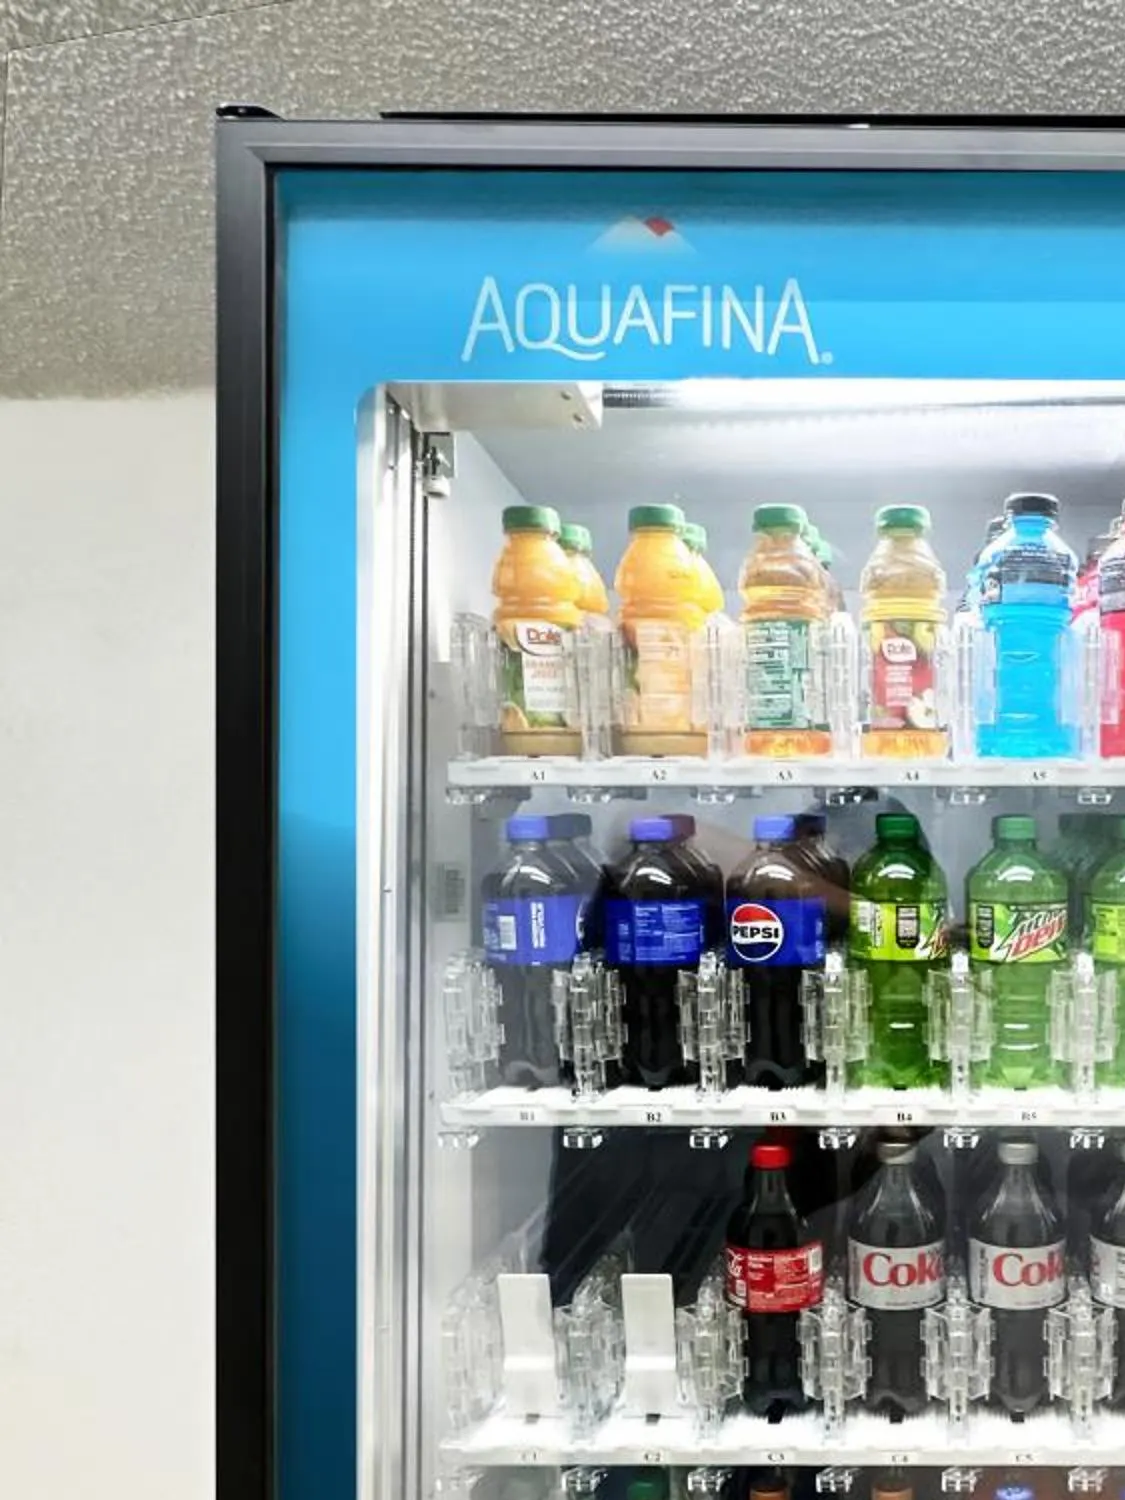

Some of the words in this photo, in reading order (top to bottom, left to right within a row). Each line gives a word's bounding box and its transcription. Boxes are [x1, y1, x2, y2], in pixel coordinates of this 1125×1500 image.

[461, 275, 825, 365] AQUAFINA
[531, 771, 545, 781] A1
[652, 769, 667, 781] A2
[777, 770, 793, 781] A3
[733, 925, 780, 939] PEPSI
[646, 1111, 662, 1122] B2
[769, 1111, 786, 1122] B3
[992, 1250, 1065, 1287] Cok
